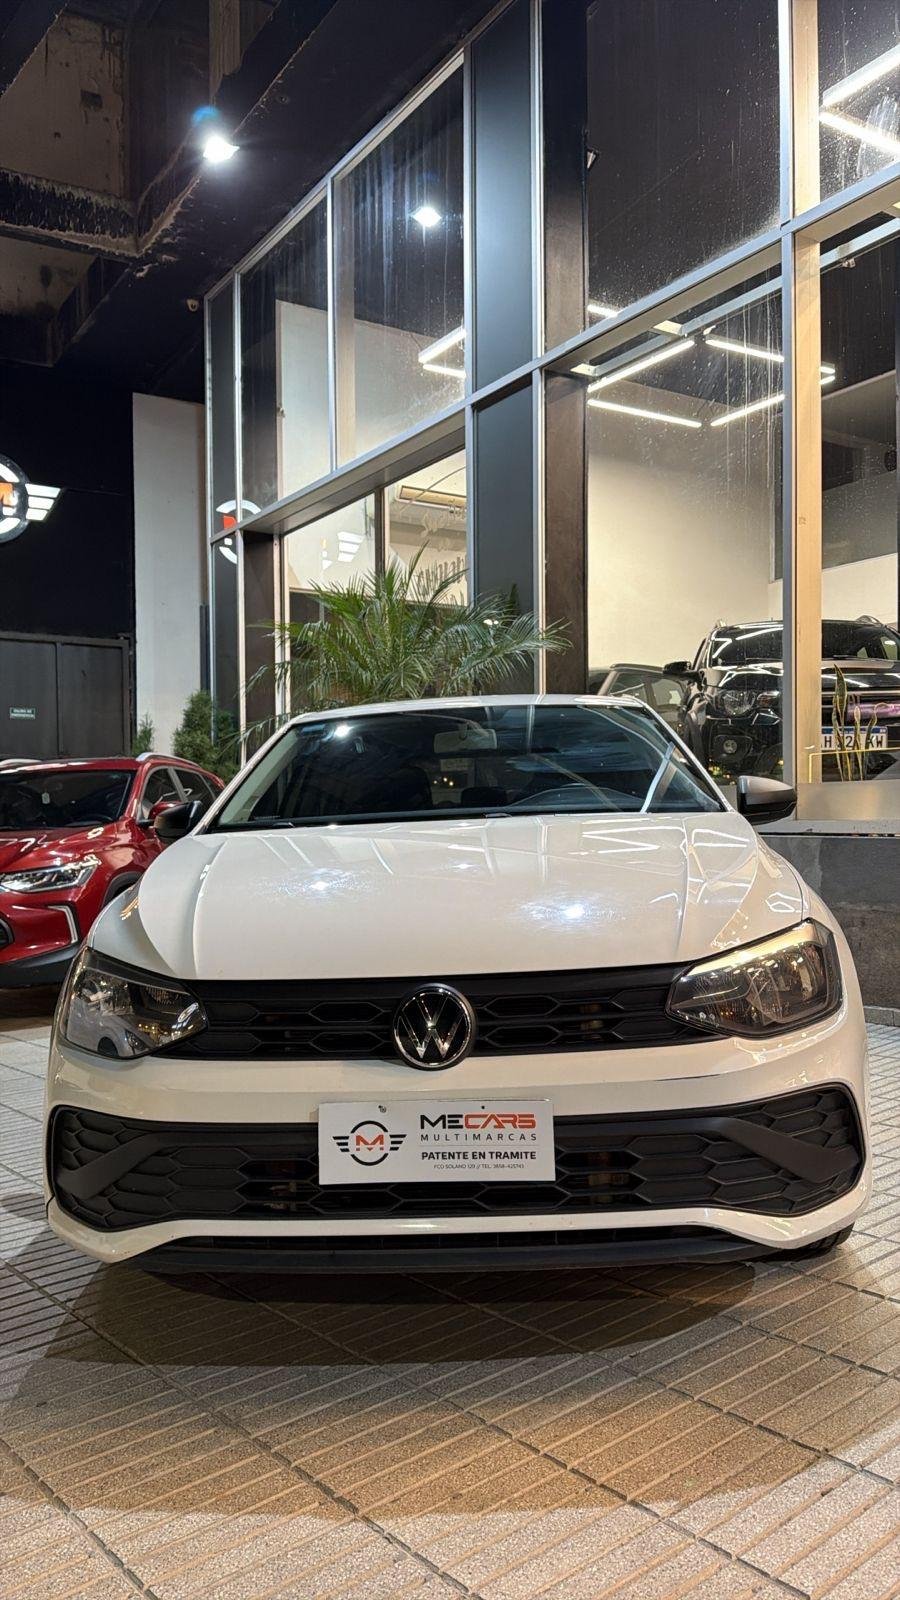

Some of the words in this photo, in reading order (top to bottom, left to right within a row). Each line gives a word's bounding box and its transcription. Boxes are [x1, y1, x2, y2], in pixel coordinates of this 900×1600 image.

[420, 1113, 537, 1130] MECARS
[420, 1133, 537, 1142] MULTIMARCAS
[421, 1151, 469, 1160] PATENTE
[471, 1151, 487, 1160] EN
[489, 1151, 537, 1160] TRAMITE
